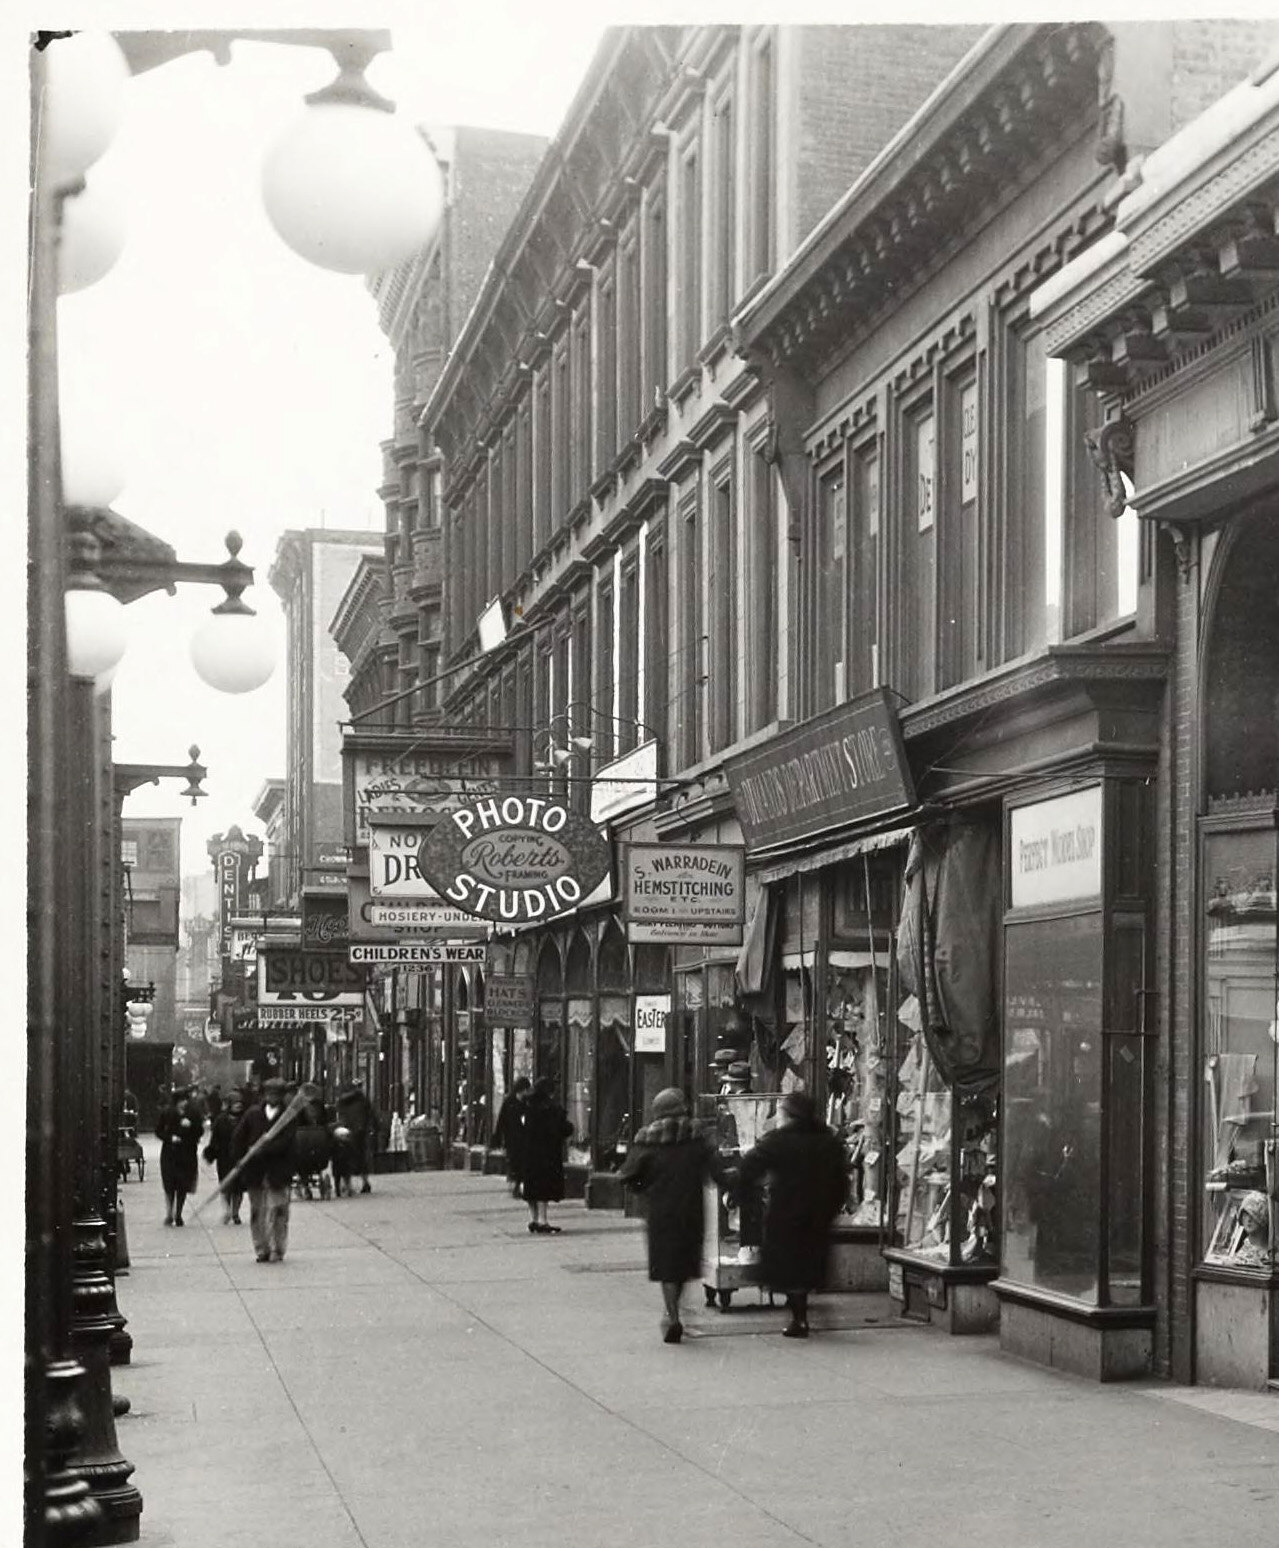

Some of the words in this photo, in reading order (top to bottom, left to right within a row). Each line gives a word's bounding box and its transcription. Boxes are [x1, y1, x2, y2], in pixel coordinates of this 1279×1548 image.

[452, 797, 567, 840] PHOTO
[383, 854, 422, 886] DR
[651, 856, 733, 879] WARRADEIN
[446, 873, 581, 919] STUDIO
[634, 880, 735, 896] HEMSTITCHING
[223, 856, 234, 952] DENTIST
[690, 908, 737, 916] UPSTAIRS
[352, 946, 442, 961] CHILDREN'S
[446, 947, 485, 961] WEAR
[271, 956, 361, 984] SHOES
[489, 987, 527, 999] HATS
[259, 1007, 297, 1020] RUBBER
[299, 1007, 328, 1020] HEELS
